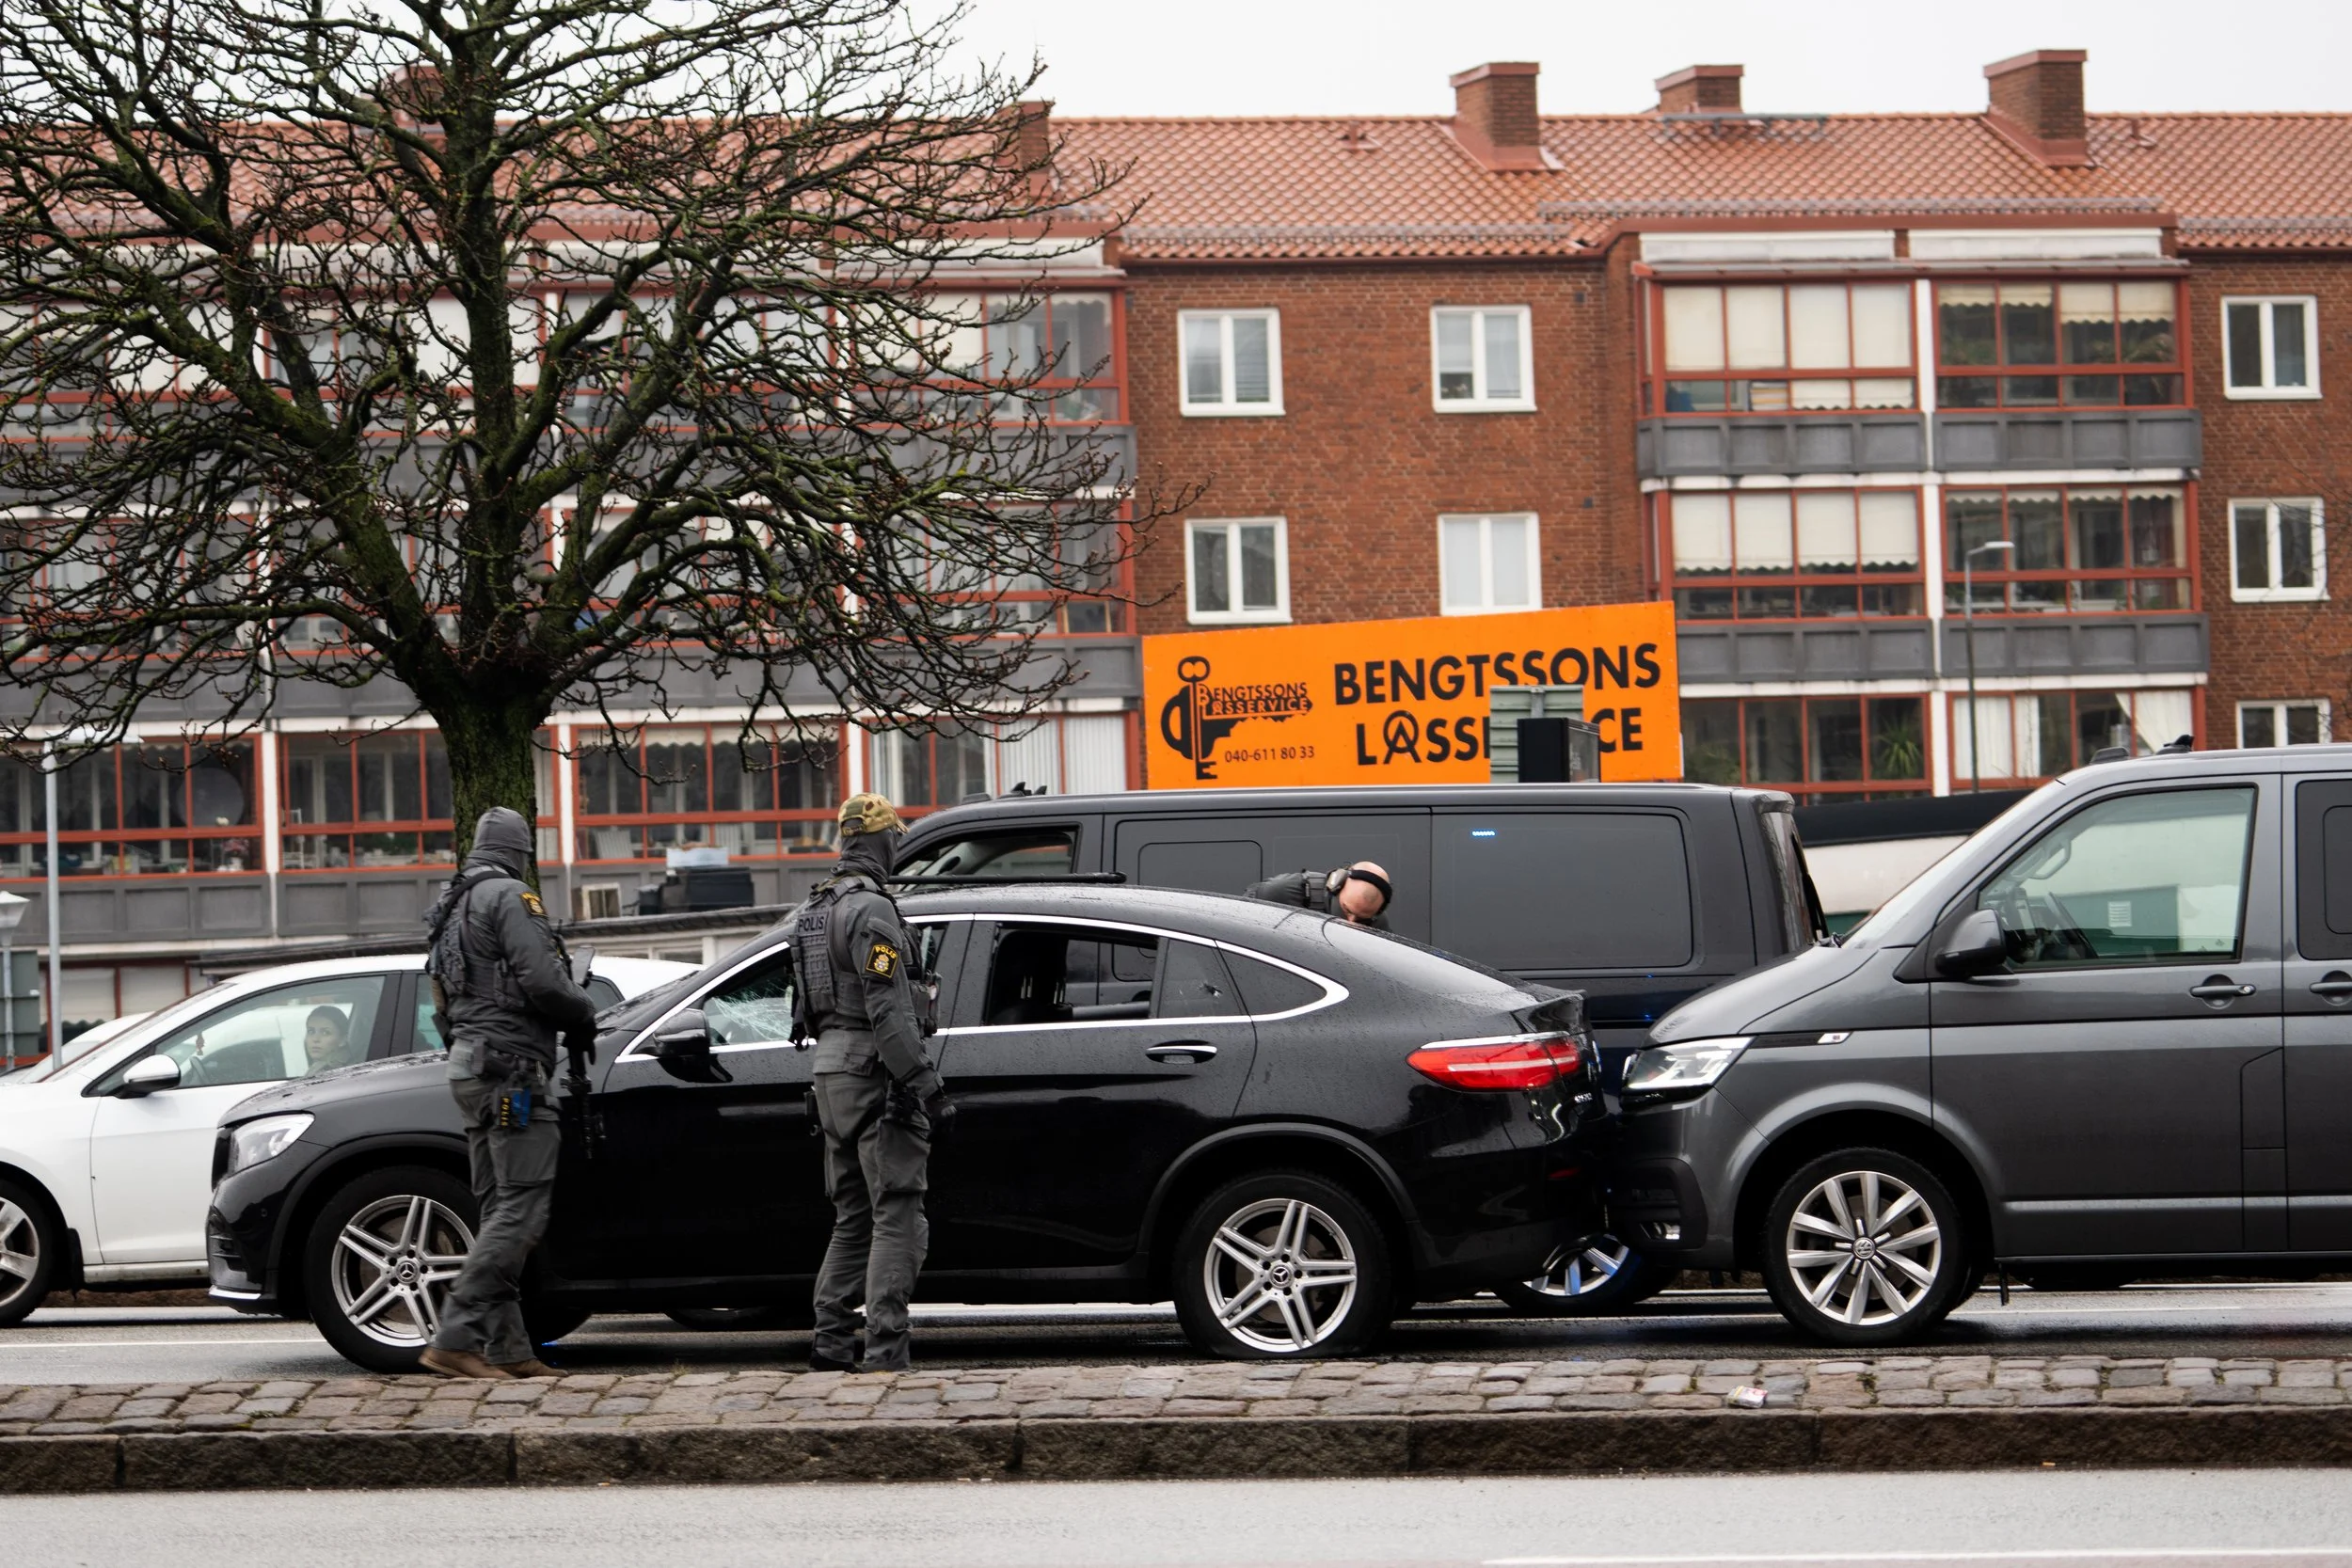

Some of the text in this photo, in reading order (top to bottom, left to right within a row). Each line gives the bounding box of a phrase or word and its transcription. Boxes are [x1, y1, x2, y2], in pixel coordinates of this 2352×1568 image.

[1334, 642, 1661, 705] BENGTSSONS
[1197, 682, 1308, 705] BENGTSSONS
[1356, 707, 1643, 766] LÅSSCE
[1225, 745, 1315, 763] 040-611 80 33
[798, 916, 824, 932] POLIS
[875, 946, 896, 958] POLIS
